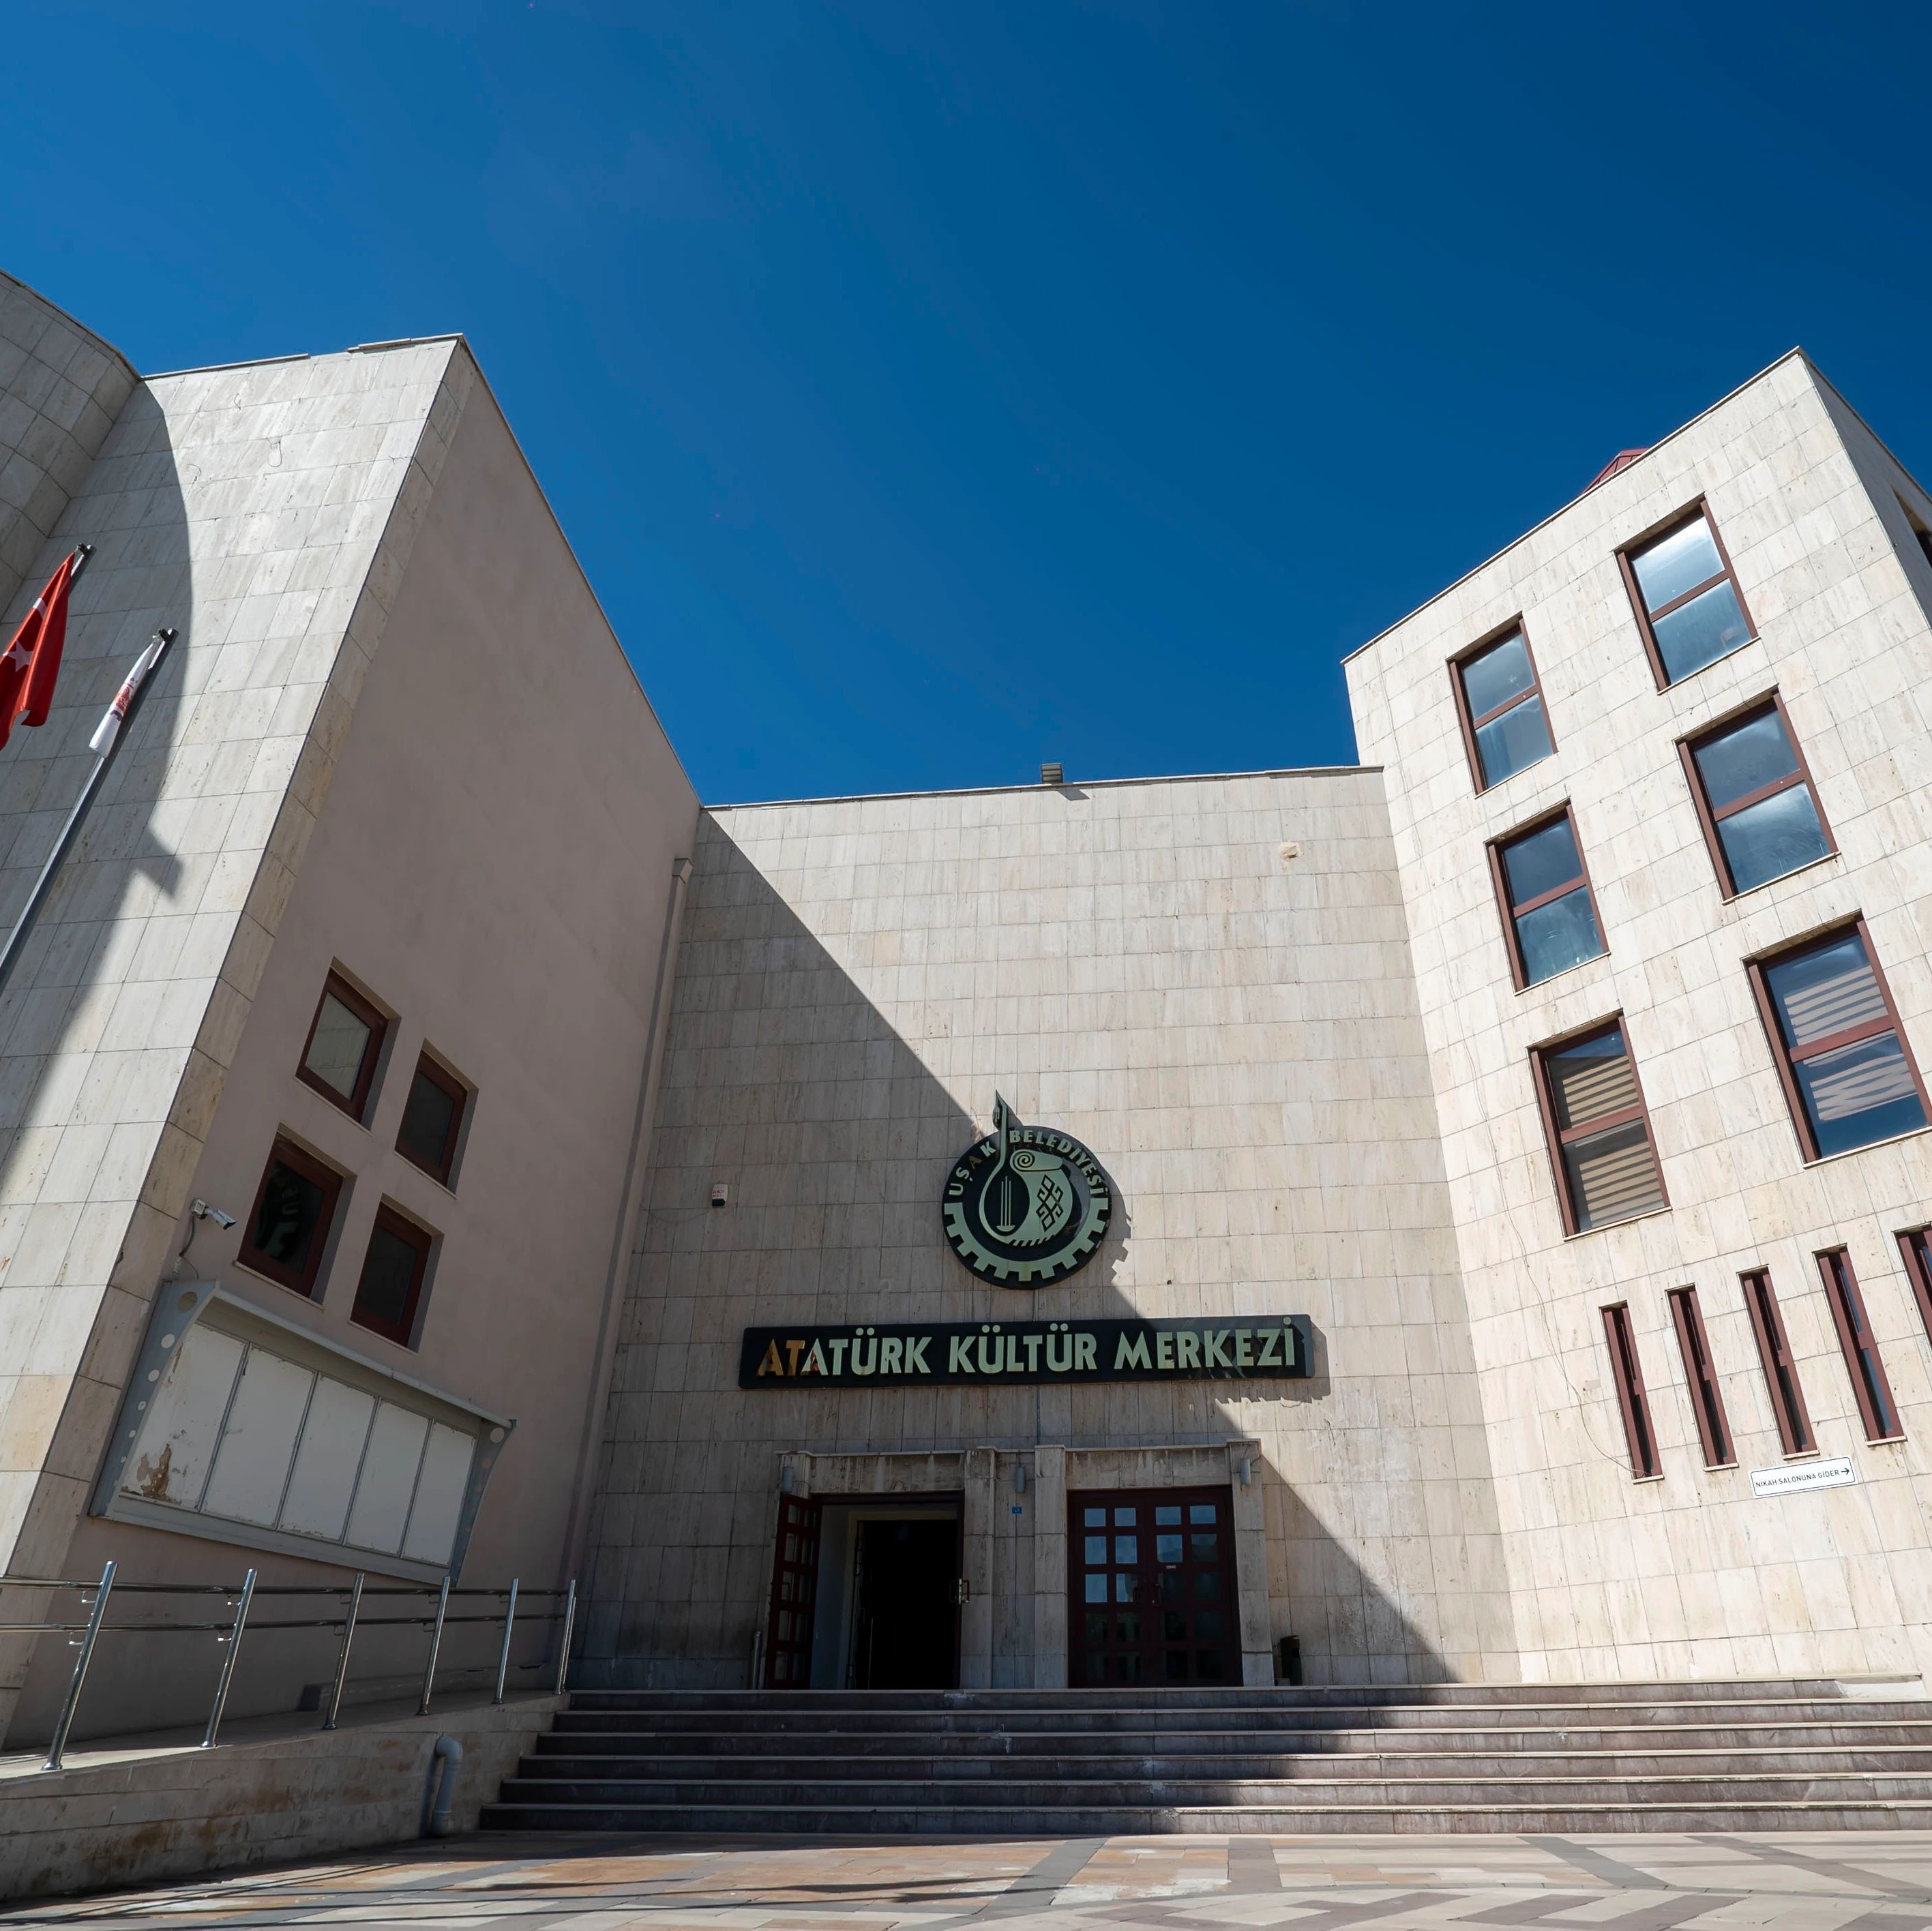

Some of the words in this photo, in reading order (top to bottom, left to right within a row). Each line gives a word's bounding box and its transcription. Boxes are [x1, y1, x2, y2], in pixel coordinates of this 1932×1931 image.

[949, 1141, 996, 1196] UŞAK
[756, 1328, 932, 1376] ATATÜRK
[949, 1323, 1097, 1374] KÜLTÜR
[1114, 1317, 1296, 1370] MERKEZİ
[1778, 1473, 1817, 1484] SALONUNA
